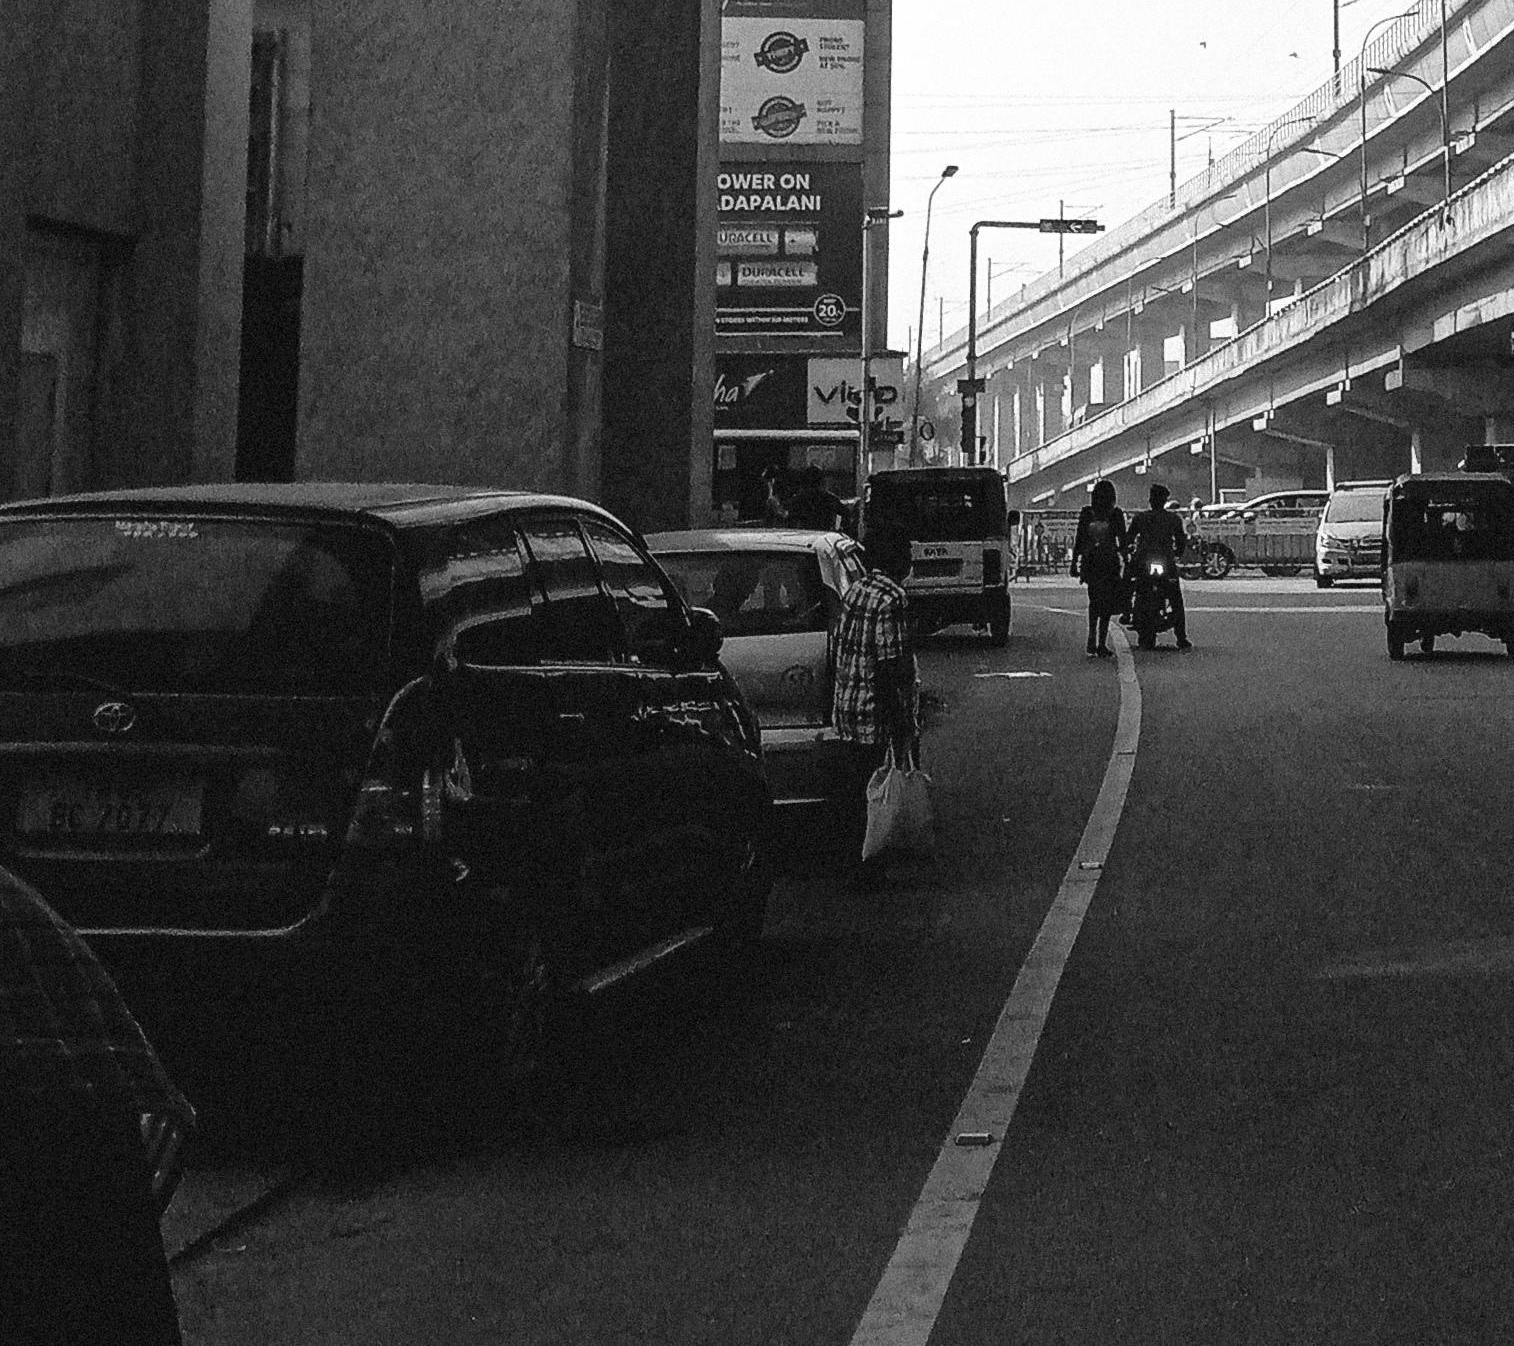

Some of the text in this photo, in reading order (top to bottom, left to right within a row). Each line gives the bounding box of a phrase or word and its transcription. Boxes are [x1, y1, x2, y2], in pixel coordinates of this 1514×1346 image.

[717, 173, 810, 190] OWER ON
[717, 195, 821, 211] DAPALANI
[741, 266, 805, 278] DURACELL
